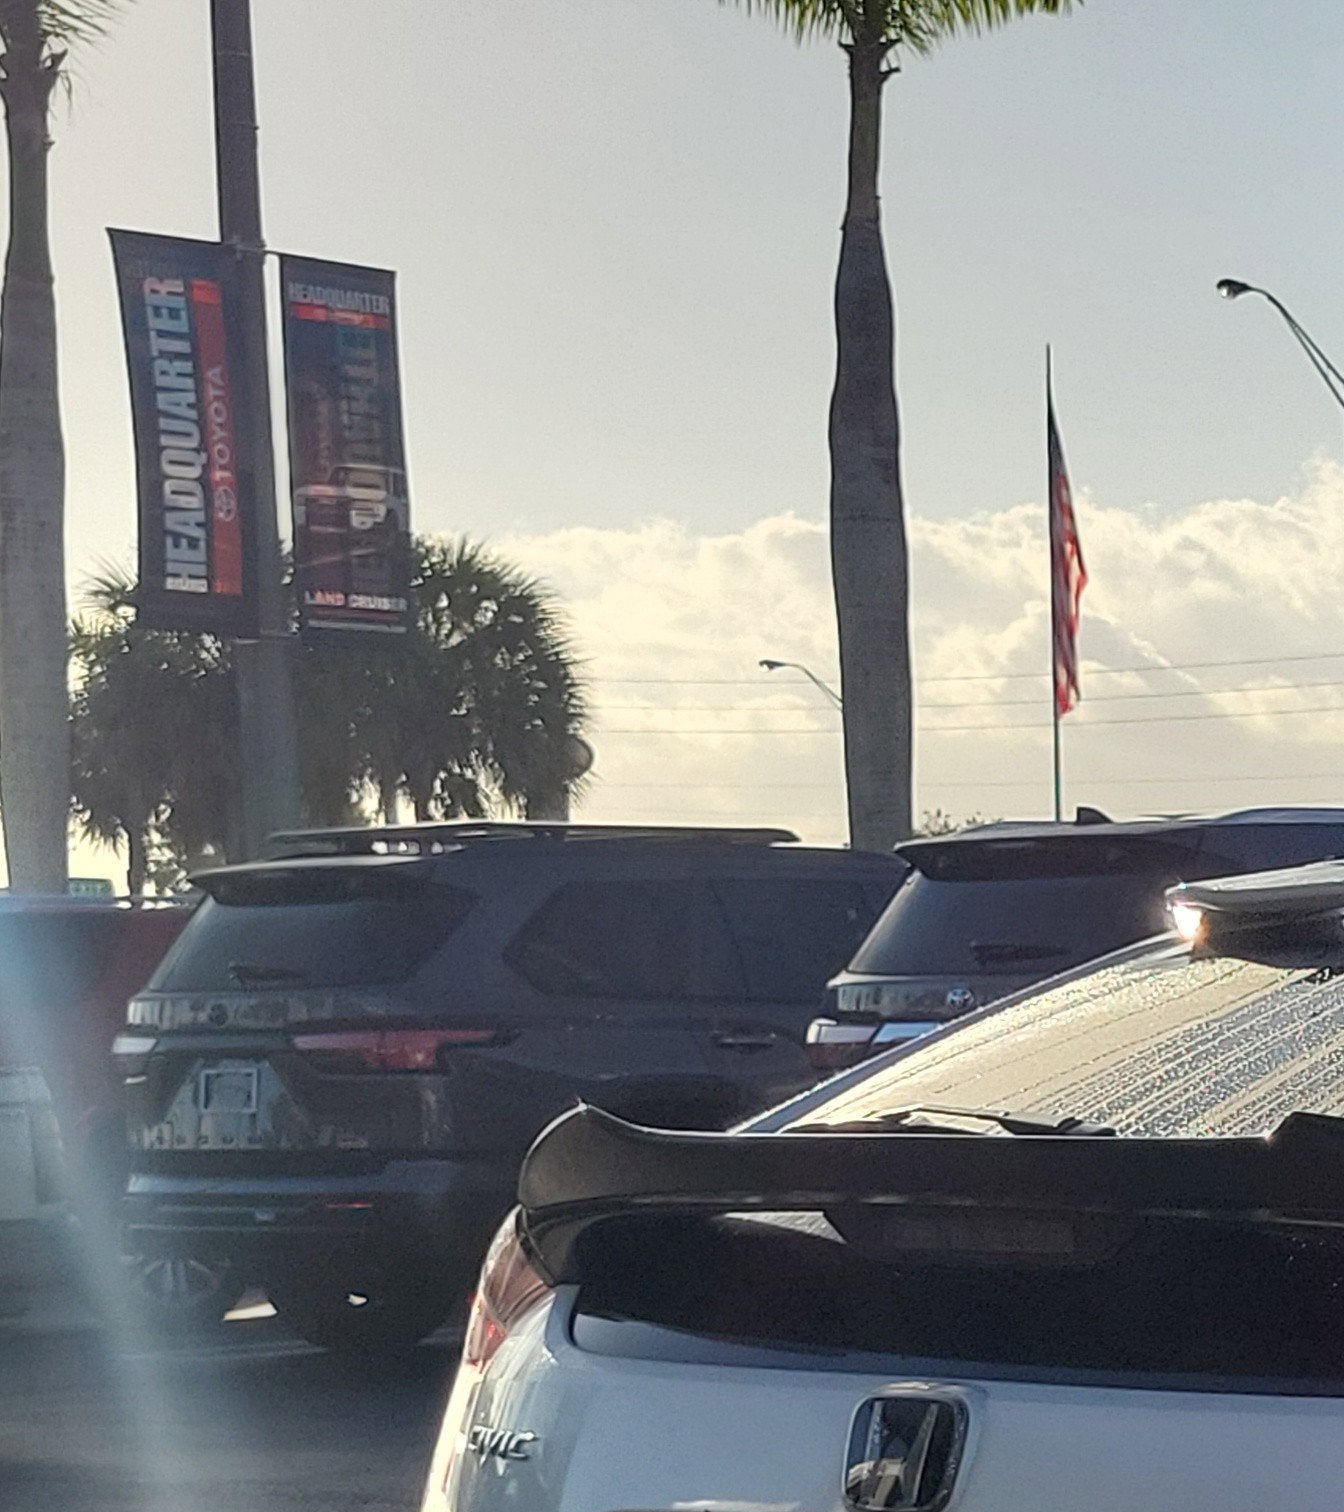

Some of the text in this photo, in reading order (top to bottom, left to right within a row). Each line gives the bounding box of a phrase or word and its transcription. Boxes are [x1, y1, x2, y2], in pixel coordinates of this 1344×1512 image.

[143, 276, 209, 594] HEADQUARTER
[205, 366, 236, 481] TOYOTA
[305, 590, 346, 607] LAND
